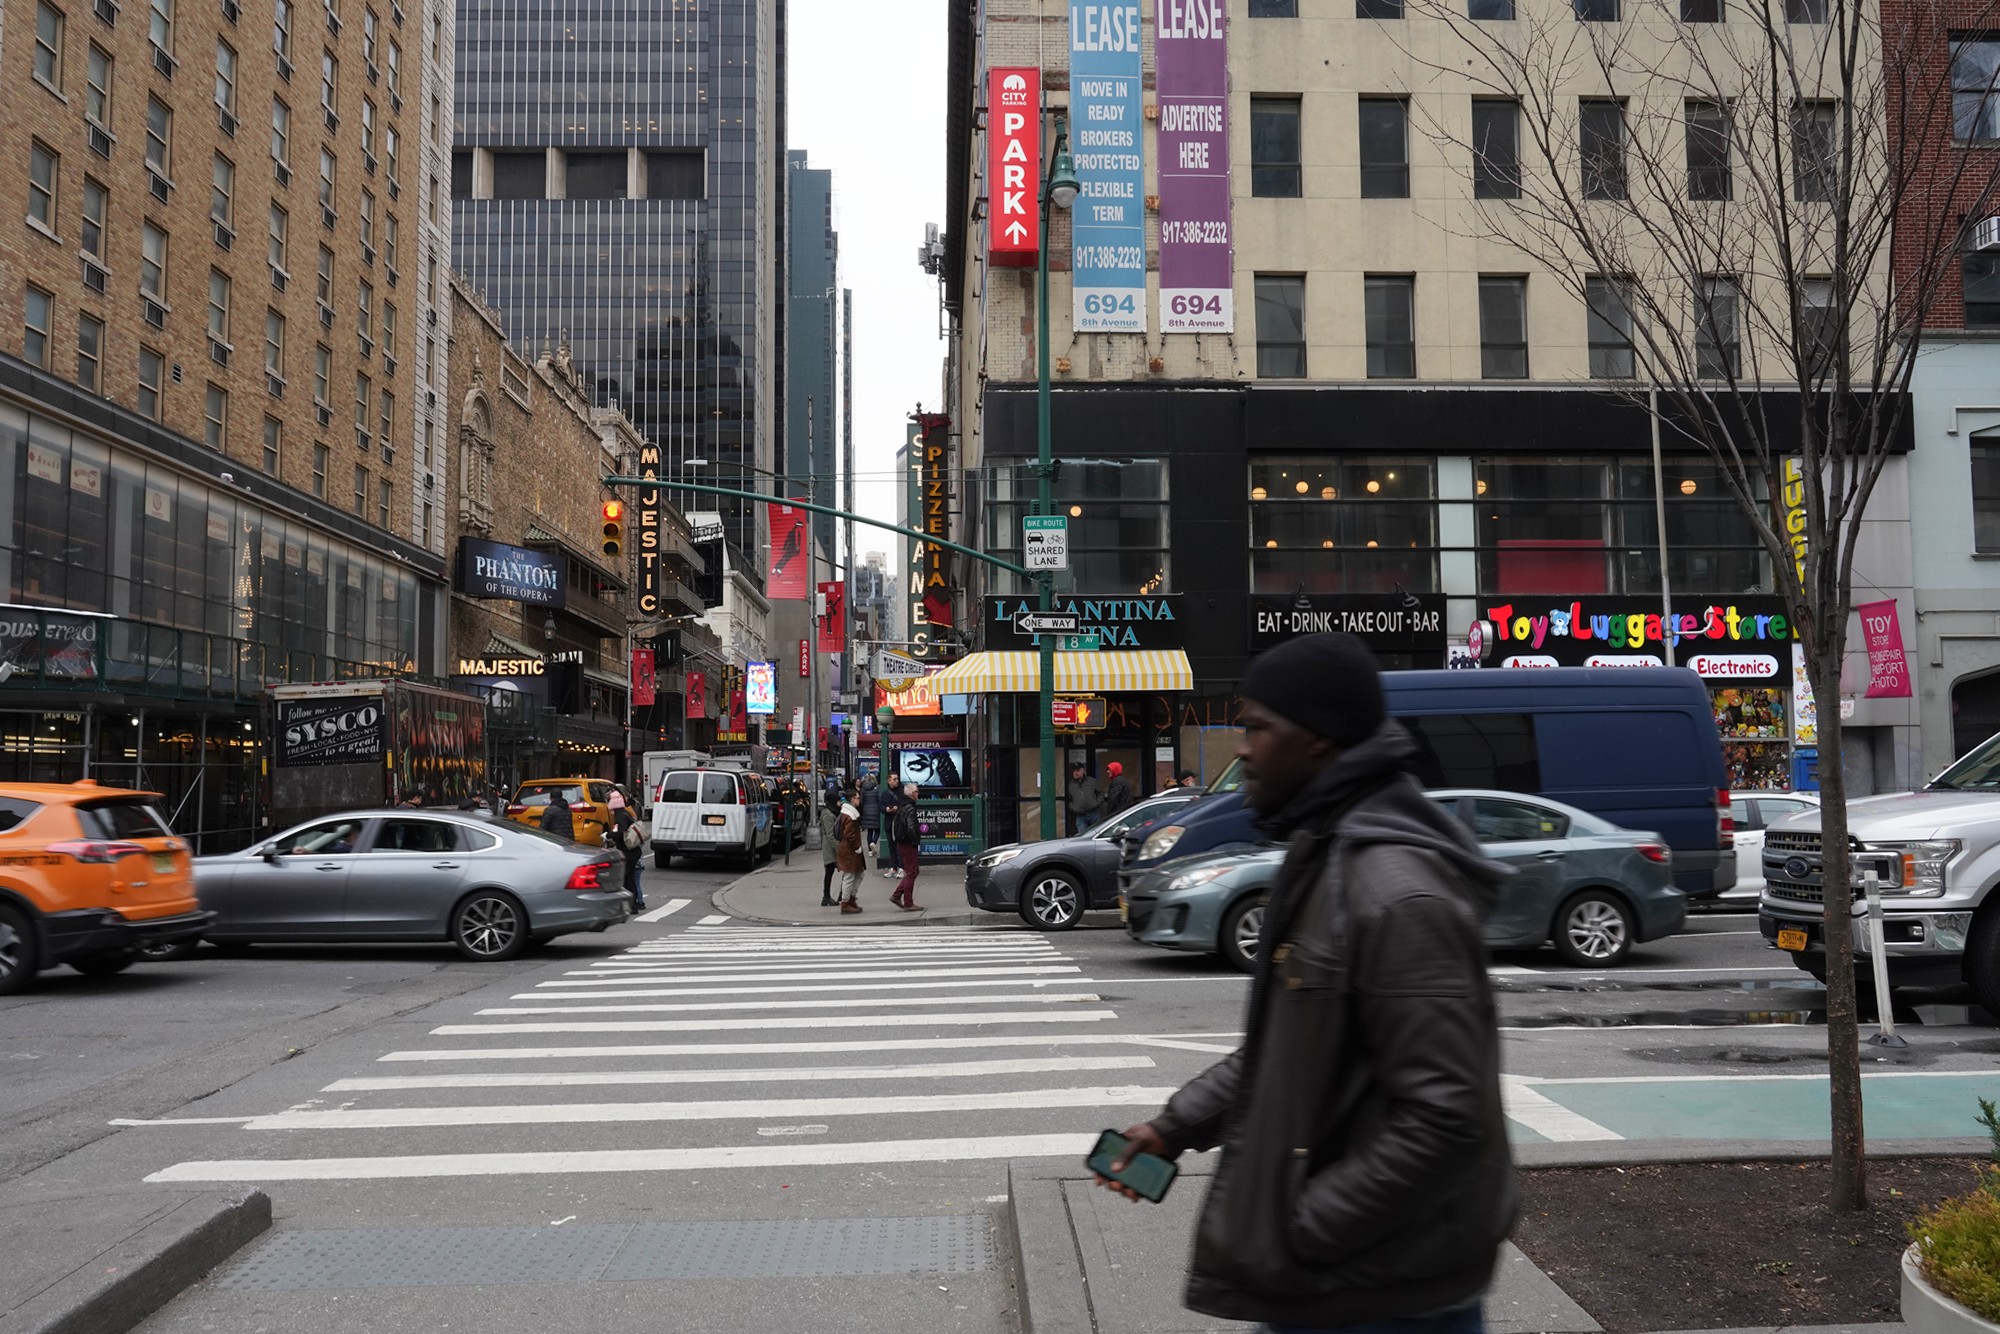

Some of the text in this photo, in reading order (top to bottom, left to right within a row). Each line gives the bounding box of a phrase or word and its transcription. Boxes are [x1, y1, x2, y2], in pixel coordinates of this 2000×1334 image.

[1158, 0, 1223, 40] LEASE
[1072, 6, 1139, 53] LEASE
[1002, 93, 1027, 101] CITY
[1081, 81, 1128, 97] MOVE IN
[1088, 105, 1125, 121] READY
[1161, 105, 1223, 132] ADVERTISE
[1080, 130, 1133, 147] BROKERS
[1002, 113, 1028, 215] PARK
[1075, 154, 1140, 171] PROTECTED
[1179, 142, 1209, 169] HERE
[1082, 182, 1134, 199] FLEXIBLE
[1092, 206, 1124, 222] TERM
[1162, 222, 1227, 244] 917-386-2232
[1076, 246, 1142, 269] 917-386-2232
[1084, 294, 1136, 314] 694
[1171, 295, 1222, 315] 694
[1081, 318, 1138, 327] 8th Avenue
[1168, 319, 1225, 327] 8th Avenue
[640, 448, 659, 611] MAJESTIC
[1043, 519, 1063, 527] ROUTE
[512, 551, 525, 560] THE
[1028, 546, 1064, 556] SHARED
[1034, 557, 1058, 566] LANE
[475, 555, 558, 591] PHANTOM
[486, 582, 548, 602] OF THE OPERA
[1057, 599, 1175, 621] ANTINA
[1024, 619, 1071, 628] ONE WAY
[1258, 611, 1440, 632] EAT DRINK TAKE OUT BAR
[1488, 601, 1787, 650] Toy Luggage Store
[1866, 614, 1892, 634] TOY
[1070, 637, 1079, 648] 8
[459, 659, 544, 676] MAJESTIC
[883, 657, 922, 674] THEATRE CIRCLE
[1697, 658, 1772, 676] Electronics
[1870, 676, 1898, 688] PHOTO
[288, 707, 313, 724] follow
[285, 706, 378, 748] SYSCO
[287, 726, 379, 756] FRESH LOCAL FOOD NYC
[348, 737, 375, 752] great
[355, 740, 380, 755] meal
[927, 810, 959, 818] Authority
